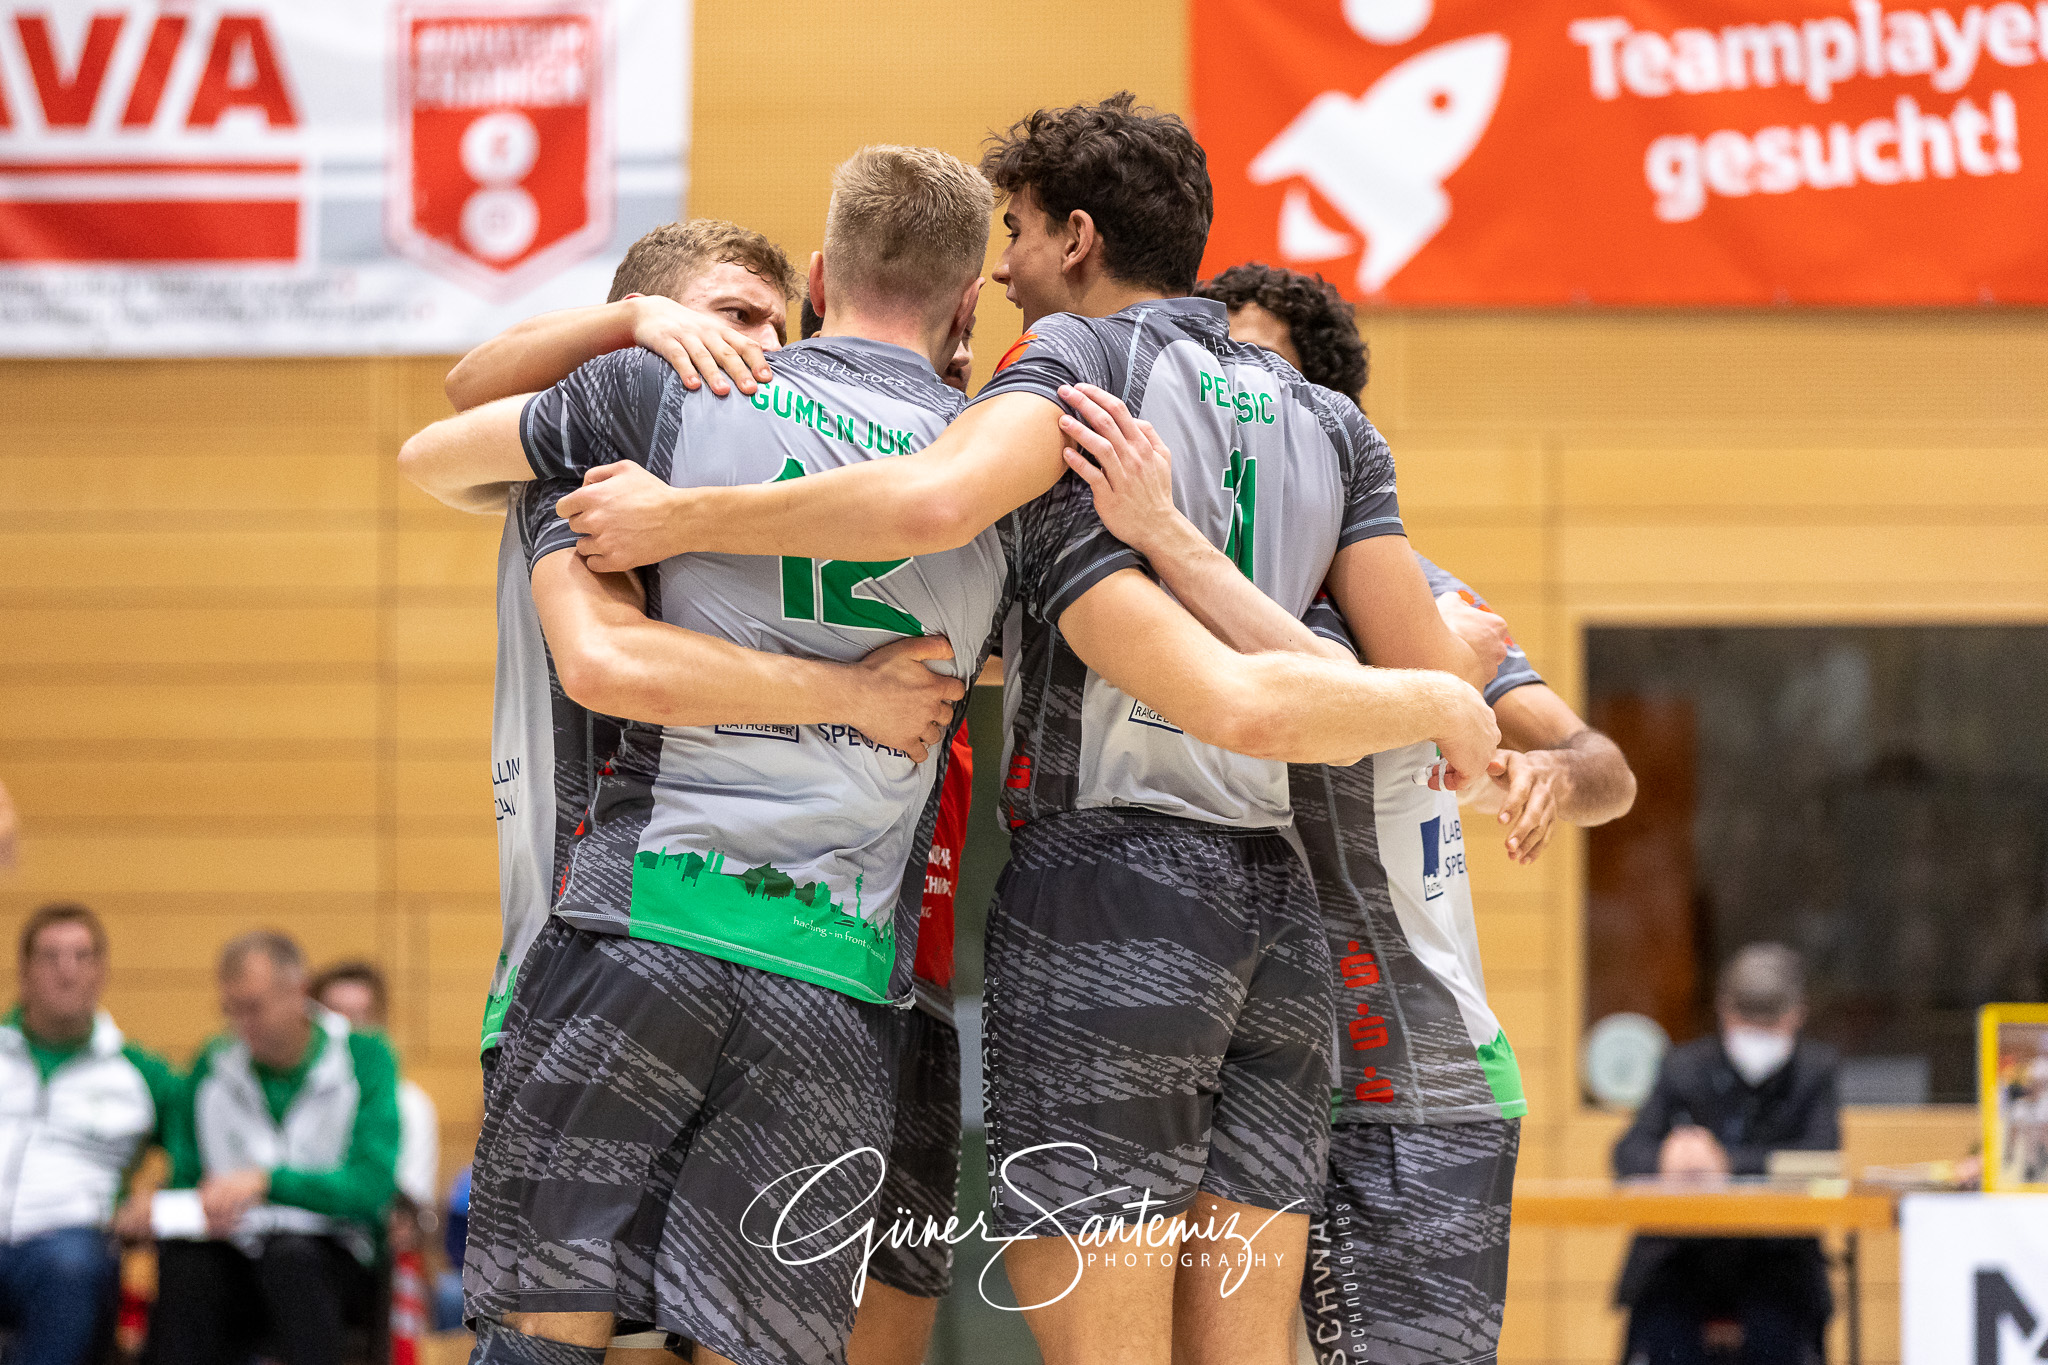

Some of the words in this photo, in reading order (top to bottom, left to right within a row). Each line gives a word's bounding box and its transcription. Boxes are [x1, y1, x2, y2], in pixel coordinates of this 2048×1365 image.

[0, 16, 300, 130] VIA
[1643, 90, 2021, 223] gesucht!
[1442, 820, 1462, 844] LAB
[845, 930, 868, 948] front
[1309, 1218, 1347, 1365] SCHWA
